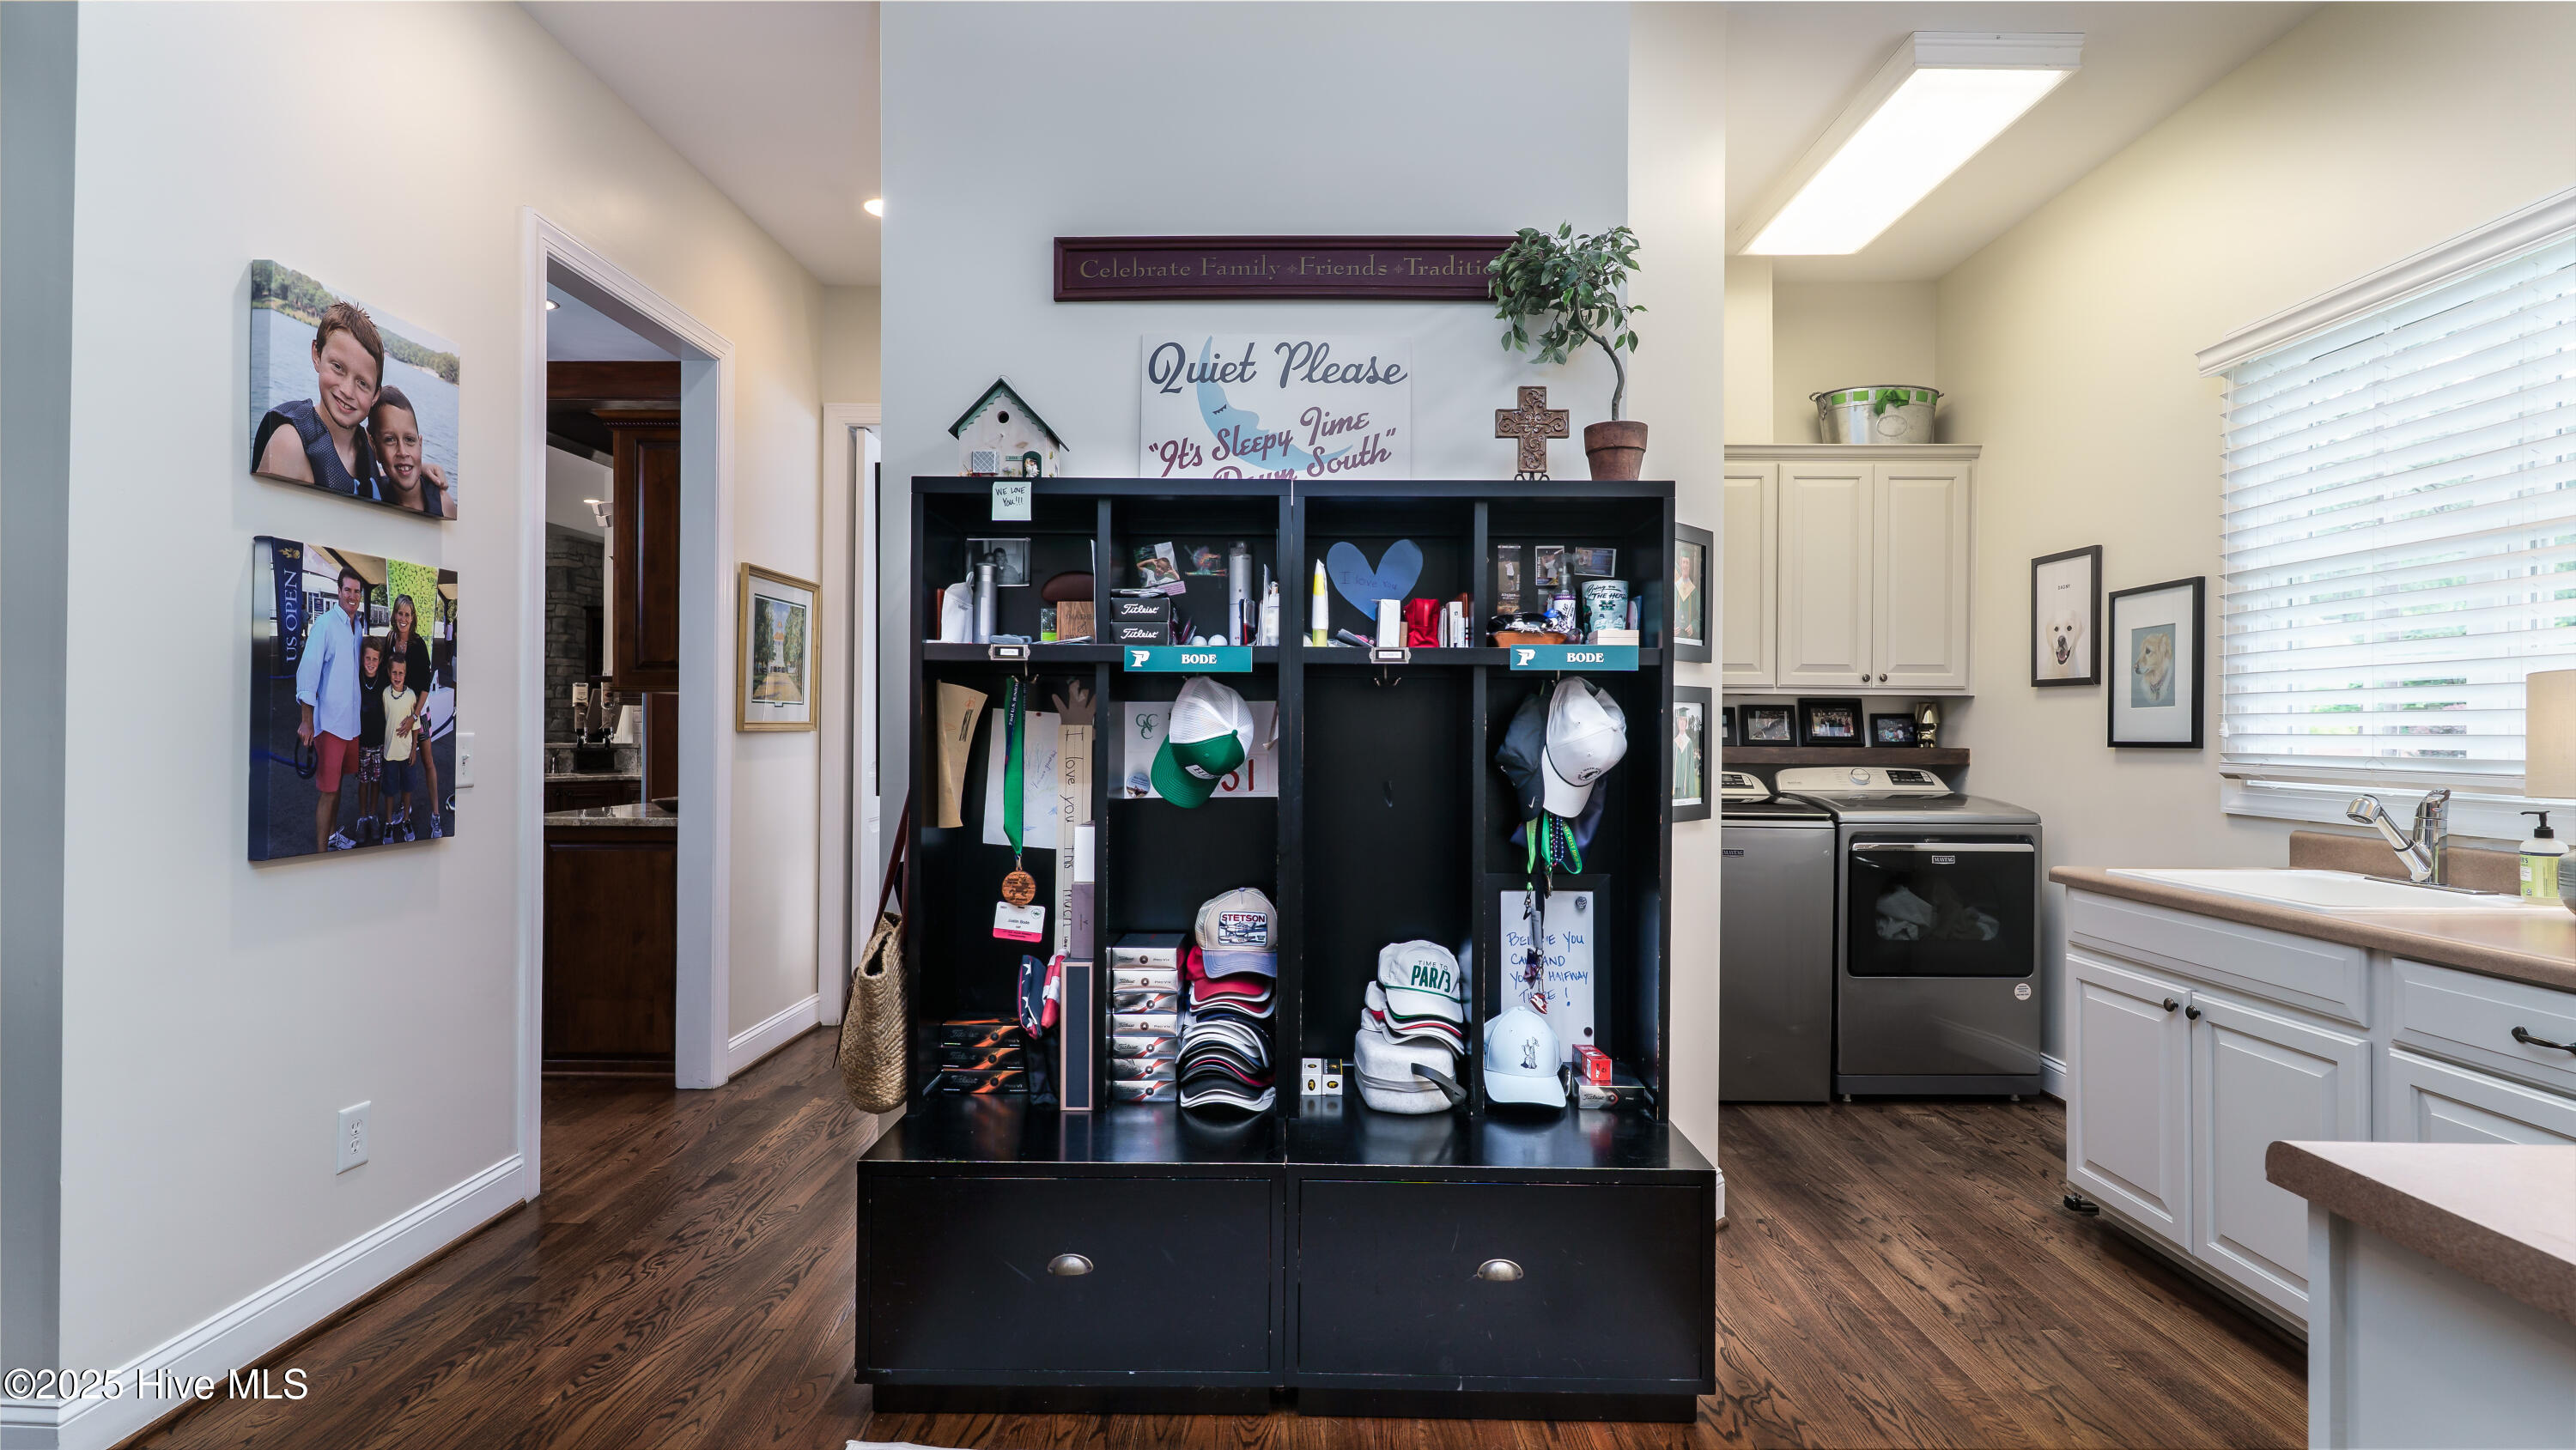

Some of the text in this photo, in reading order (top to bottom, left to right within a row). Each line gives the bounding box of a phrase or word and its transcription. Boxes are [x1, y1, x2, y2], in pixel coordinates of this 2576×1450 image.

[1079, 257, 1191, 279] Celebrate
[1201, 254, 1281, 281] Family
[1298, 254, 1388, 276] Friends
[1148, 340, 1407, 394] Quiet Please
[1212, 424, 1294, 461] Sleepy
[1299, 406, 1370, 446] Time
[995, 486, 1025, 496] WE LOVE
[1339, 571, 1352, 585] I
[283, 568, 298, 663] US OPEN
[1121, 603, 1160, 616] Titleist
[1120, 628, 1159, 640] Titleist
[1181, 653, 1218, 664] BODE
[1566, 652, 1604, 663] BODE
[1065, 728, 1084, 741] I
[1065, 756, 1084, 786] love
[1060, 794, 1074, 823] you
[1221, 913, 1266, 923] STETSON
[1542, 955, 1565, 968] AND
